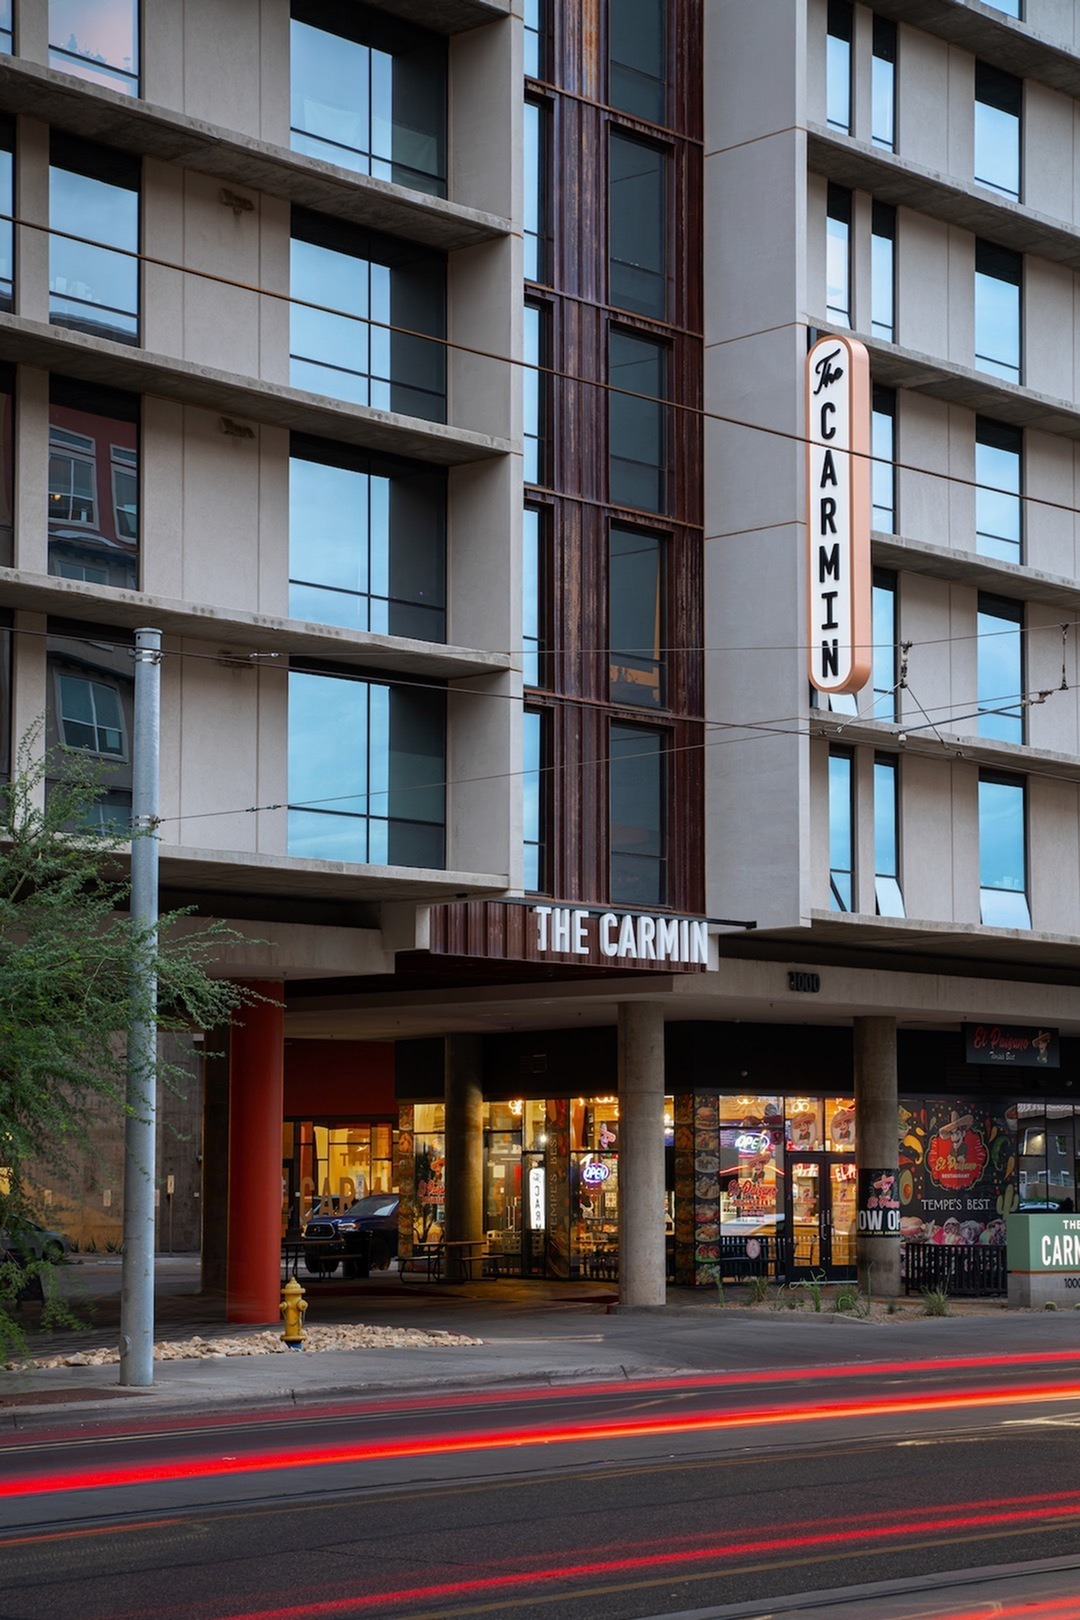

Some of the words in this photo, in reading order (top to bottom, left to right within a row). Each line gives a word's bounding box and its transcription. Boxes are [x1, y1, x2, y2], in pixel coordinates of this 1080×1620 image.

[813, 348, 844, 395] The
[818, 401, 840, 678] CARMIN
[535, 905, 590, 955] THE
[600, 911, 708, 964] CARMIN
[973, 1026, 987, 1049] El
[921, 1198, 962, 1211] TEMPE'S
[967, 1199, 990, 1211] BEST
[857, 1209, 883, 1231] OW
[1062, 1219, 1080, 1230] THE
